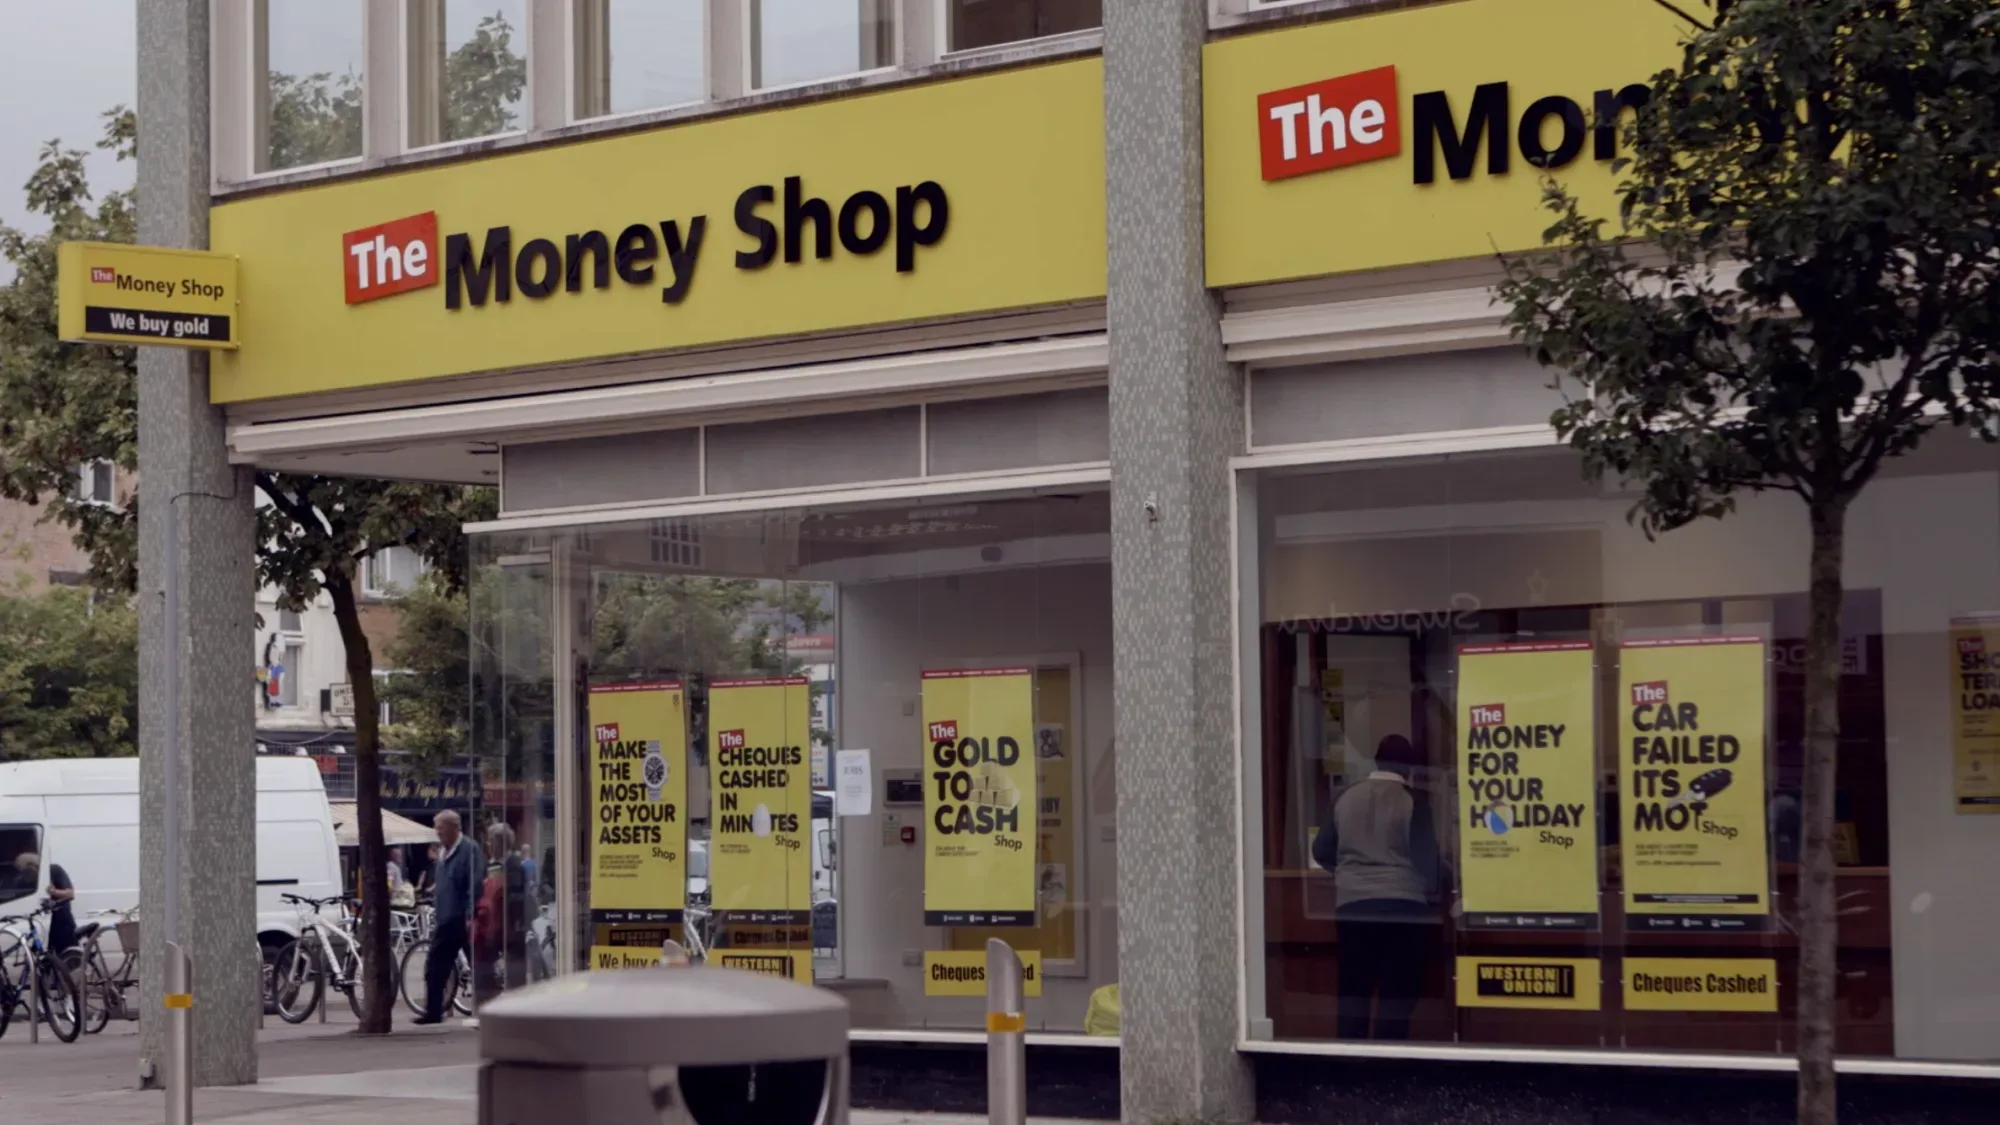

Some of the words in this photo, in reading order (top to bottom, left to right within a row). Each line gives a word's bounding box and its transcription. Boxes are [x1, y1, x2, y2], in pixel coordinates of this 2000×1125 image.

[1269, 92, 1387, 162] The
[350, 234, 428, 290] The
[445, 214, 707, 310] Money
[734, 175, 949, 273] Shop
[92, 269, 113, 281] The
[116, 274, 176, 298] Money
[181, 278, 224, 301] Shop
[109, 312, 135, 330] We
[139, 313, 169, 336] buy
[174, 318, 209, 337] gold
[1960, 673, 2000, 690] TER
[1633, 685, 1666, 703] The
[1472, 708, 1502, 724] The
[1633, 702, 1698, 731] CAR
[596, 726, 617, 740] The
[720, 731, 742, 747] The
[931, 724, 956, 739] The
[1468, 724, 1566, 749] MONEY
[599, 741, 647, 759] MAKE
[718, 746, 802, 768] CHEQUES
[933, 736, 1019, 768] GOLD
[1633, 735, 1740, 765] FAILED
[599, 762, 631, 780] THE
[1468, 752, 1519, 776] FOR
[719, 769, 789, 789] CASHED
[933, 770, 974, 801] TO
[1634, 769, 1681, 798] ITS
[600, 783, 648, 802] MOST
[1468, 778, 1543, 801] YOUR
[720, 792, 737, 811] IN
[600, 805, 622, 823] OF
[626, 803, 676, 822] YOUR
[720, 813, 799, 833] MINTES
[935, 804, 1018, 835] CASH
[1470, 803, 1585, 828] HLIDAY
[1634, 802, 1708, 831] MOT
[599, 825, 662, 844] ASSETS
[1539, 830, 1574, 849] Shop
[1702, 821, 1738, 840] Shop
[775, 834, 801, 851] Shop
[994, 834, 1022, 852] Shop
[652, 846, 676, 862] Shop
[599, 954, 618, 969] We
[724, 956, 780, 970] WESTERN
[931, 962, 985, 982] Cheques
[1480, 966, 1557, 980] WESTERN
[1503, 981, 1557, 993] UNION
[1632, 973, 1702, 993] Cheques
[1706, 973, 1767, 993] Cashed
